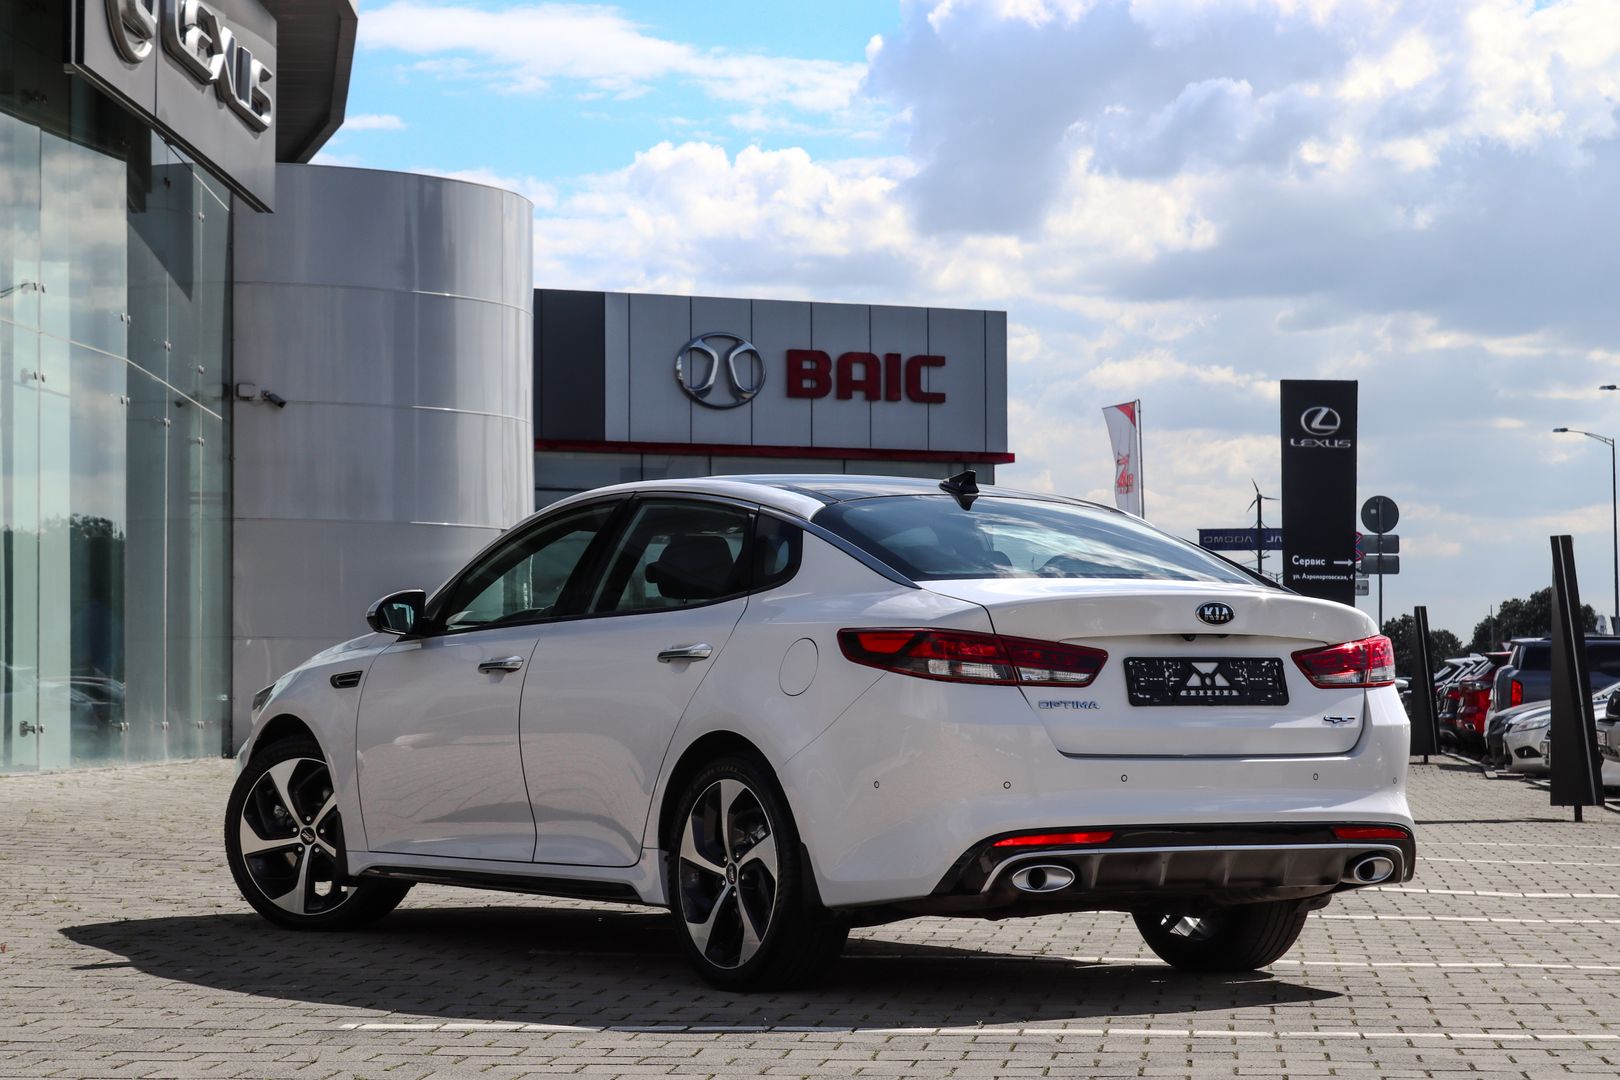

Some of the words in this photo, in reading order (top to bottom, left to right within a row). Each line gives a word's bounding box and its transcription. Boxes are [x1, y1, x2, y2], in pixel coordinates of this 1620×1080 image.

[786, 349, 947, 404] BAIC
[1290, 438, 1352, 448] LEXUS
[1292, 554, 1326, 567] Сервис
[1203, 606, 1231, 621] KIA
[1038, 700, 1101, 710] OPTIMA
